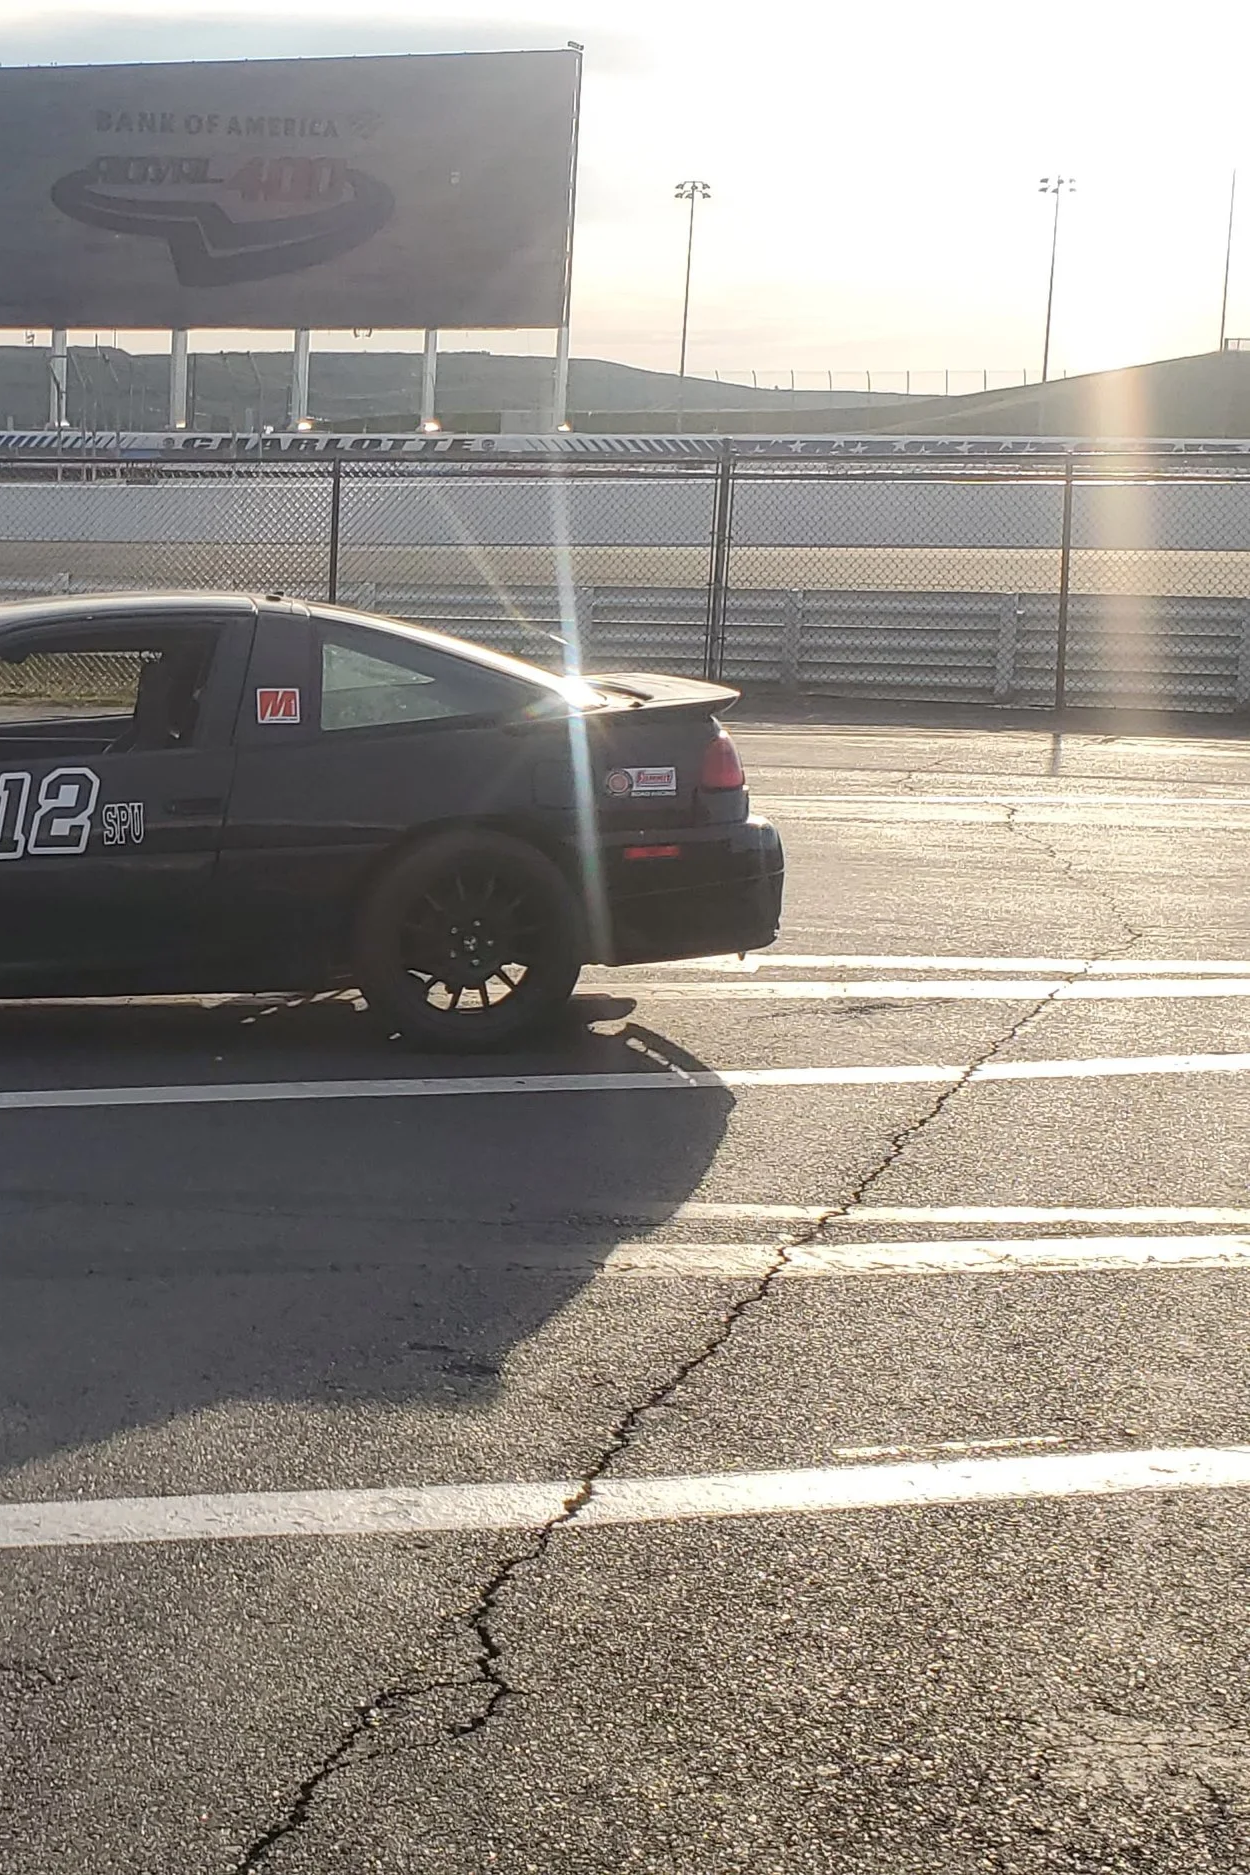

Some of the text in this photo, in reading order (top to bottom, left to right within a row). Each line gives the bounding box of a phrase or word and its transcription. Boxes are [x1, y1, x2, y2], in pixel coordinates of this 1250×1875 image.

[95, 110, 340, 138] BANK OF AMERICA
[181, 436, 476, 451] CHARLOTTE
[103, 803, 144, 845] SPU
